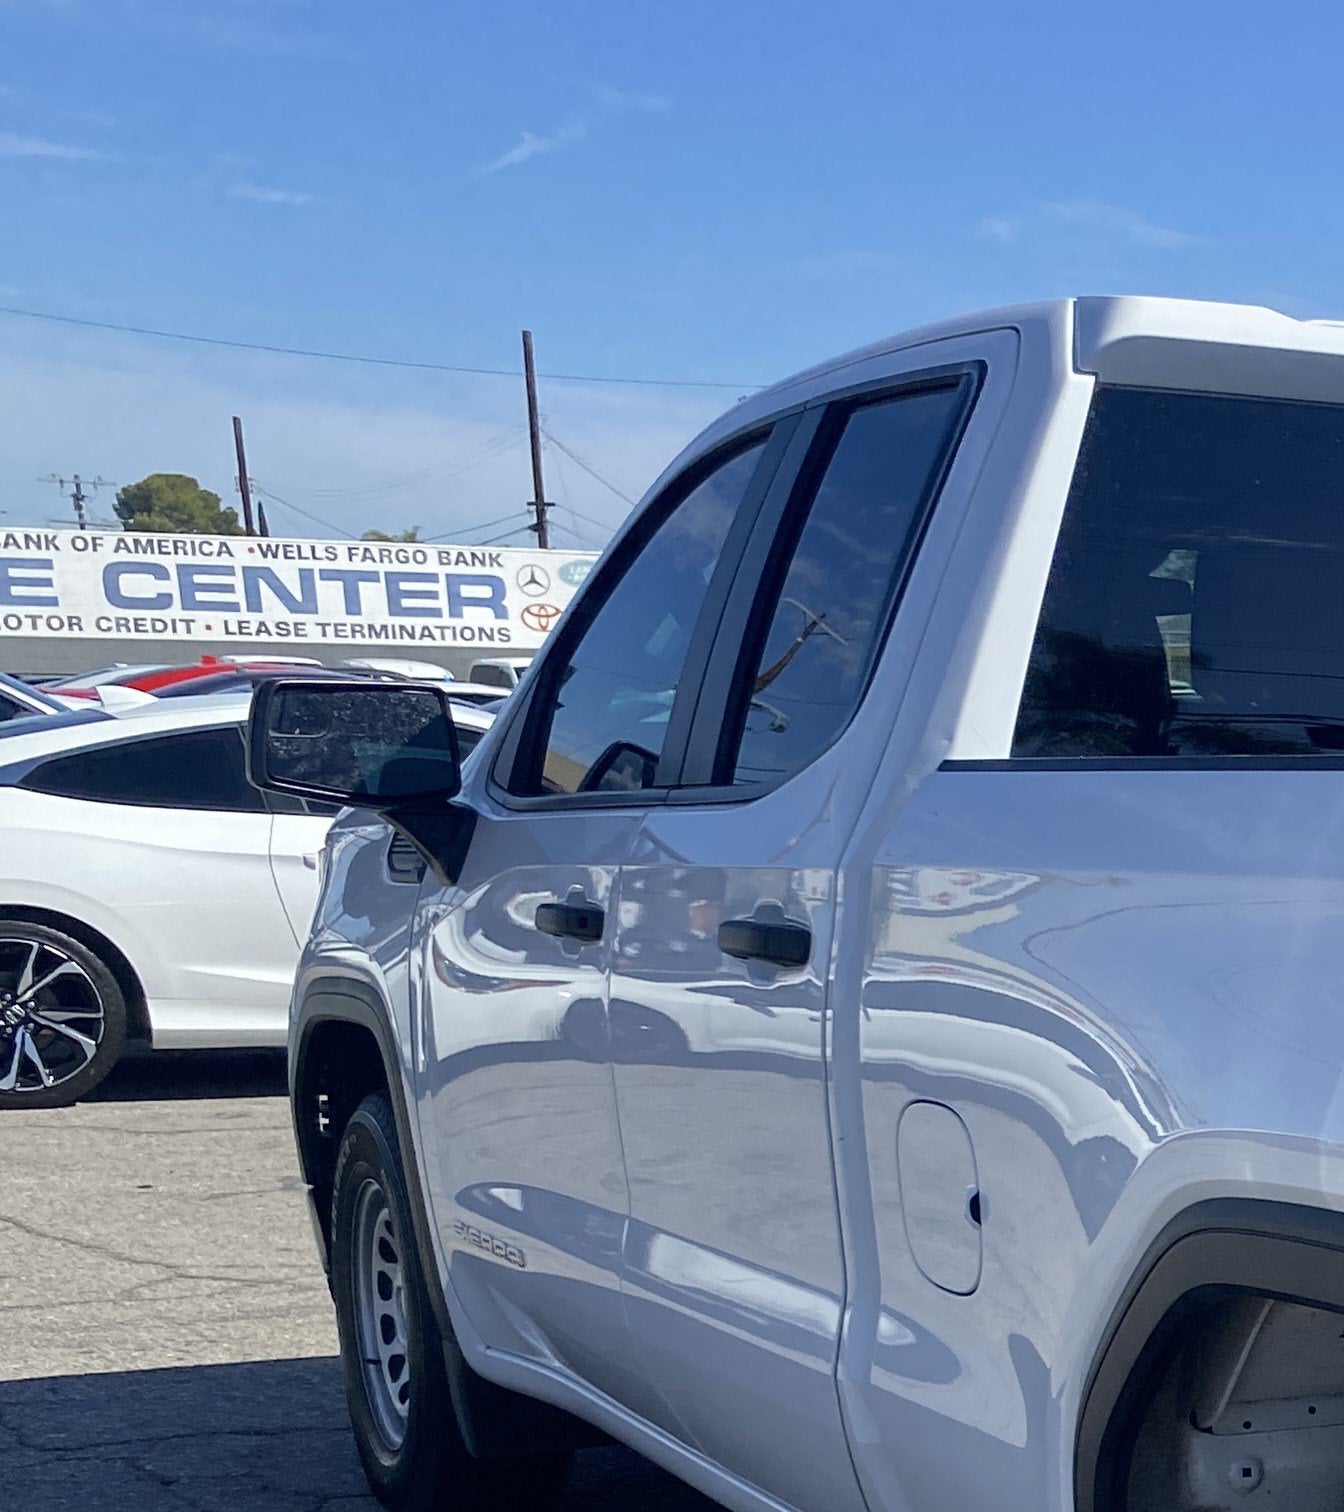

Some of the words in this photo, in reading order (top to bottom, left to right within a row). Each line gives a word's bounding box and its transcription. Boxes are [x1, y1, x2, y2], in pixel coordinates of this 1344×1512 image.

[0, 532, 61, 551] ANK
[70, 535, 104, 552] OF
[113, 537, 235, 557] AMERICA
[257, 543, 338, 561] WELLS
[347, 546, 428, 565] FARGO
[437, 549, 504, 568] BANK
[102, 561, 509, 620] CENTER
[0, 613, 84, 632] OTOR
[95, 616, 196, 635] CREDIT
[223, 620, 308, 638] LEASE
[313, 622, 511, 643] TERMINATIONS
